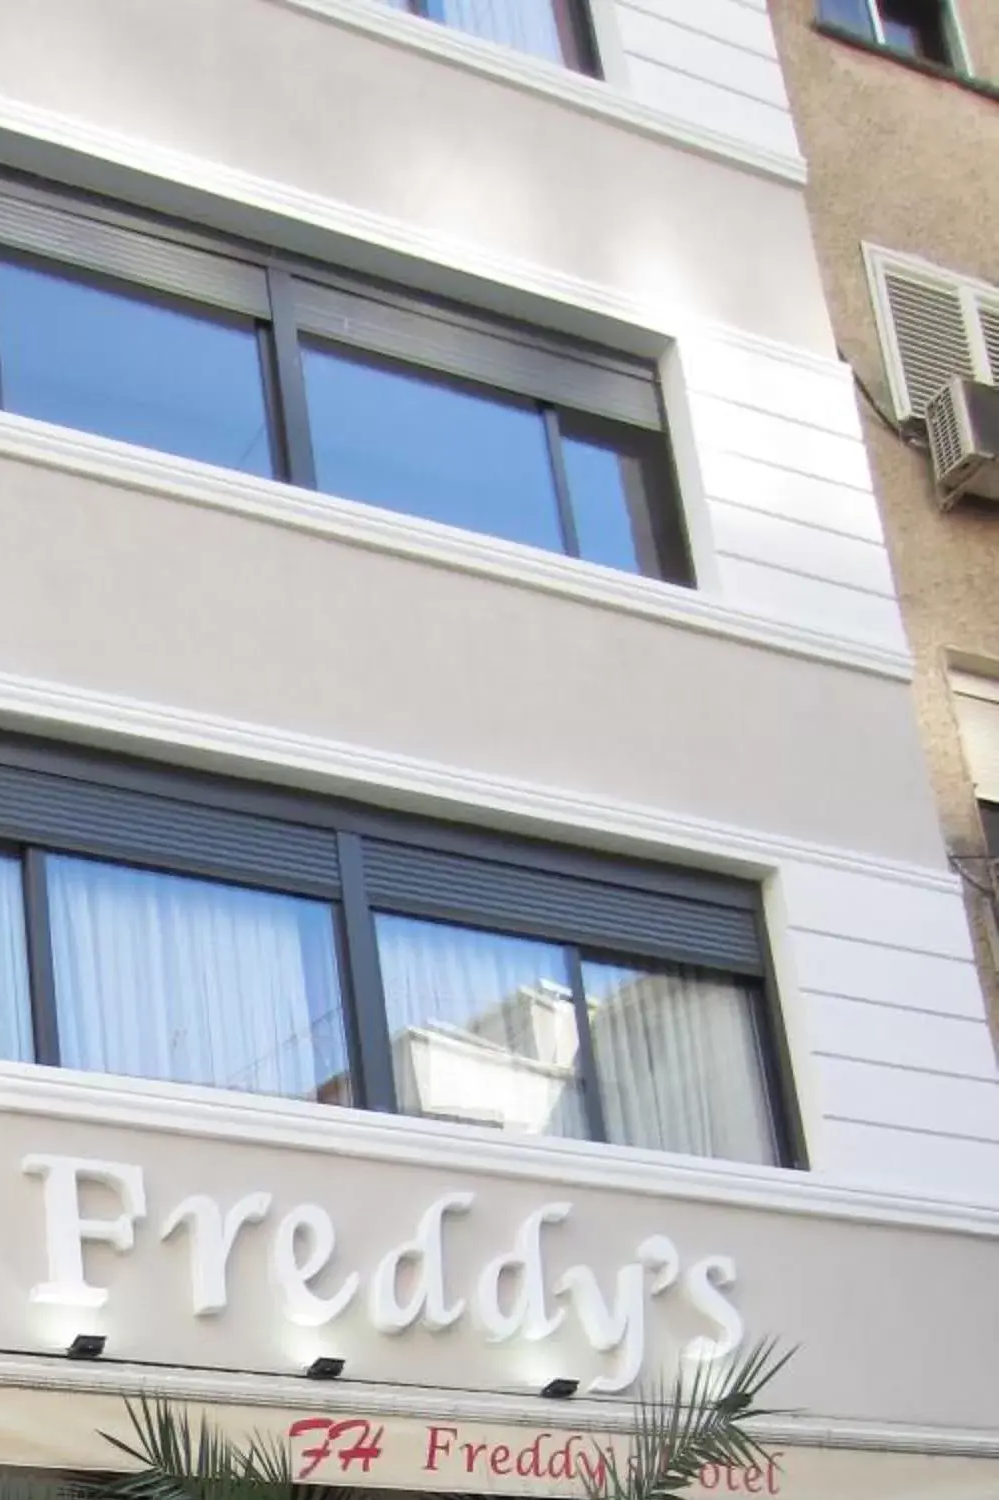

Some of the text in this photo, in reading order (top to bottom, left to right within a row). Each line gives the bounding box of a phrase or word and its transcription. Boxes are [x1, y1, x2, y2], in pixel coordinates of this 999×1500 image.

[22, 1152, 744, 1393] Freddy's
[289, 1418, 384, 1479] FH
[656, 1442, 785, 1495] otel
